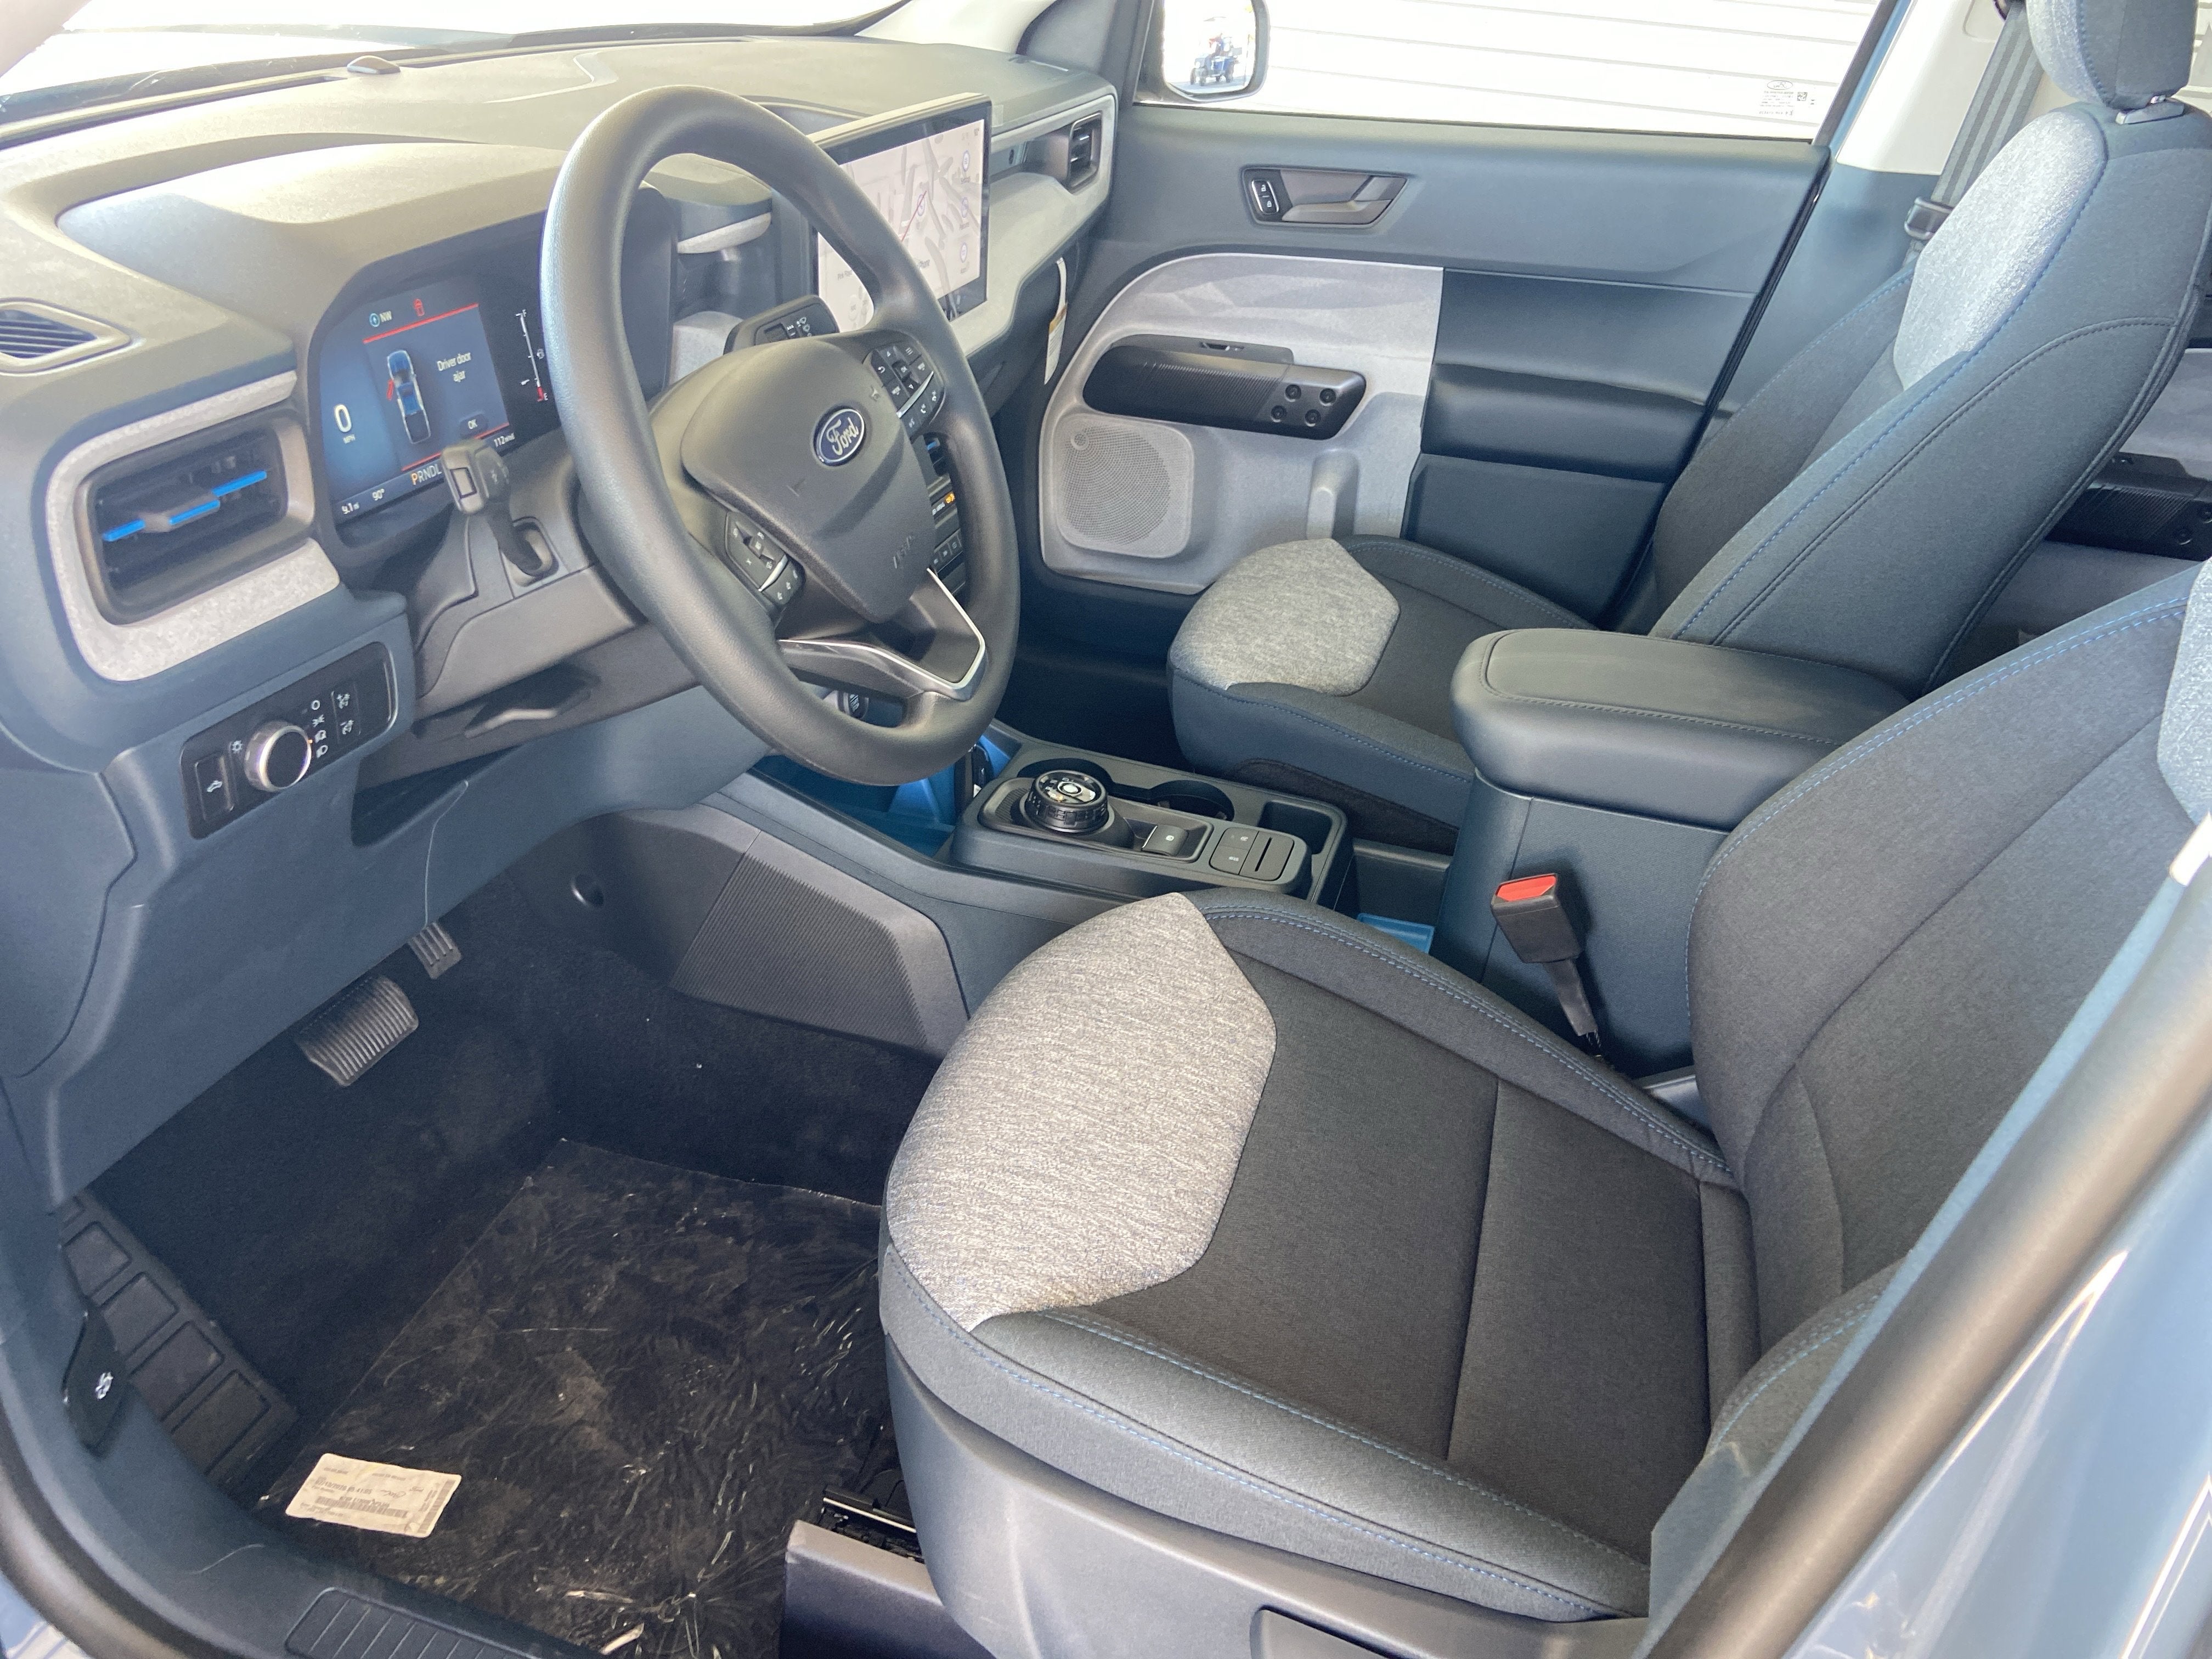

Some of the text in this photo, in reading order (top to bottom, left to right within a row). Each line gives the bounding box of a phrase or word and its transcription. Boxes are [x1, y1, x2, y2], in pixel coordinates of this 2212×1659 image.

[380, 311, 392, 322] NW
[437, 352, 472, 372] Driver door
[453, 369, 466, 383] ajar
[334, 404, 352, 432] 0
[467, 418, 478, 430] OK
[826, 416, 860, 456] Ford
[411, 464, 443, 486] PRNDL
